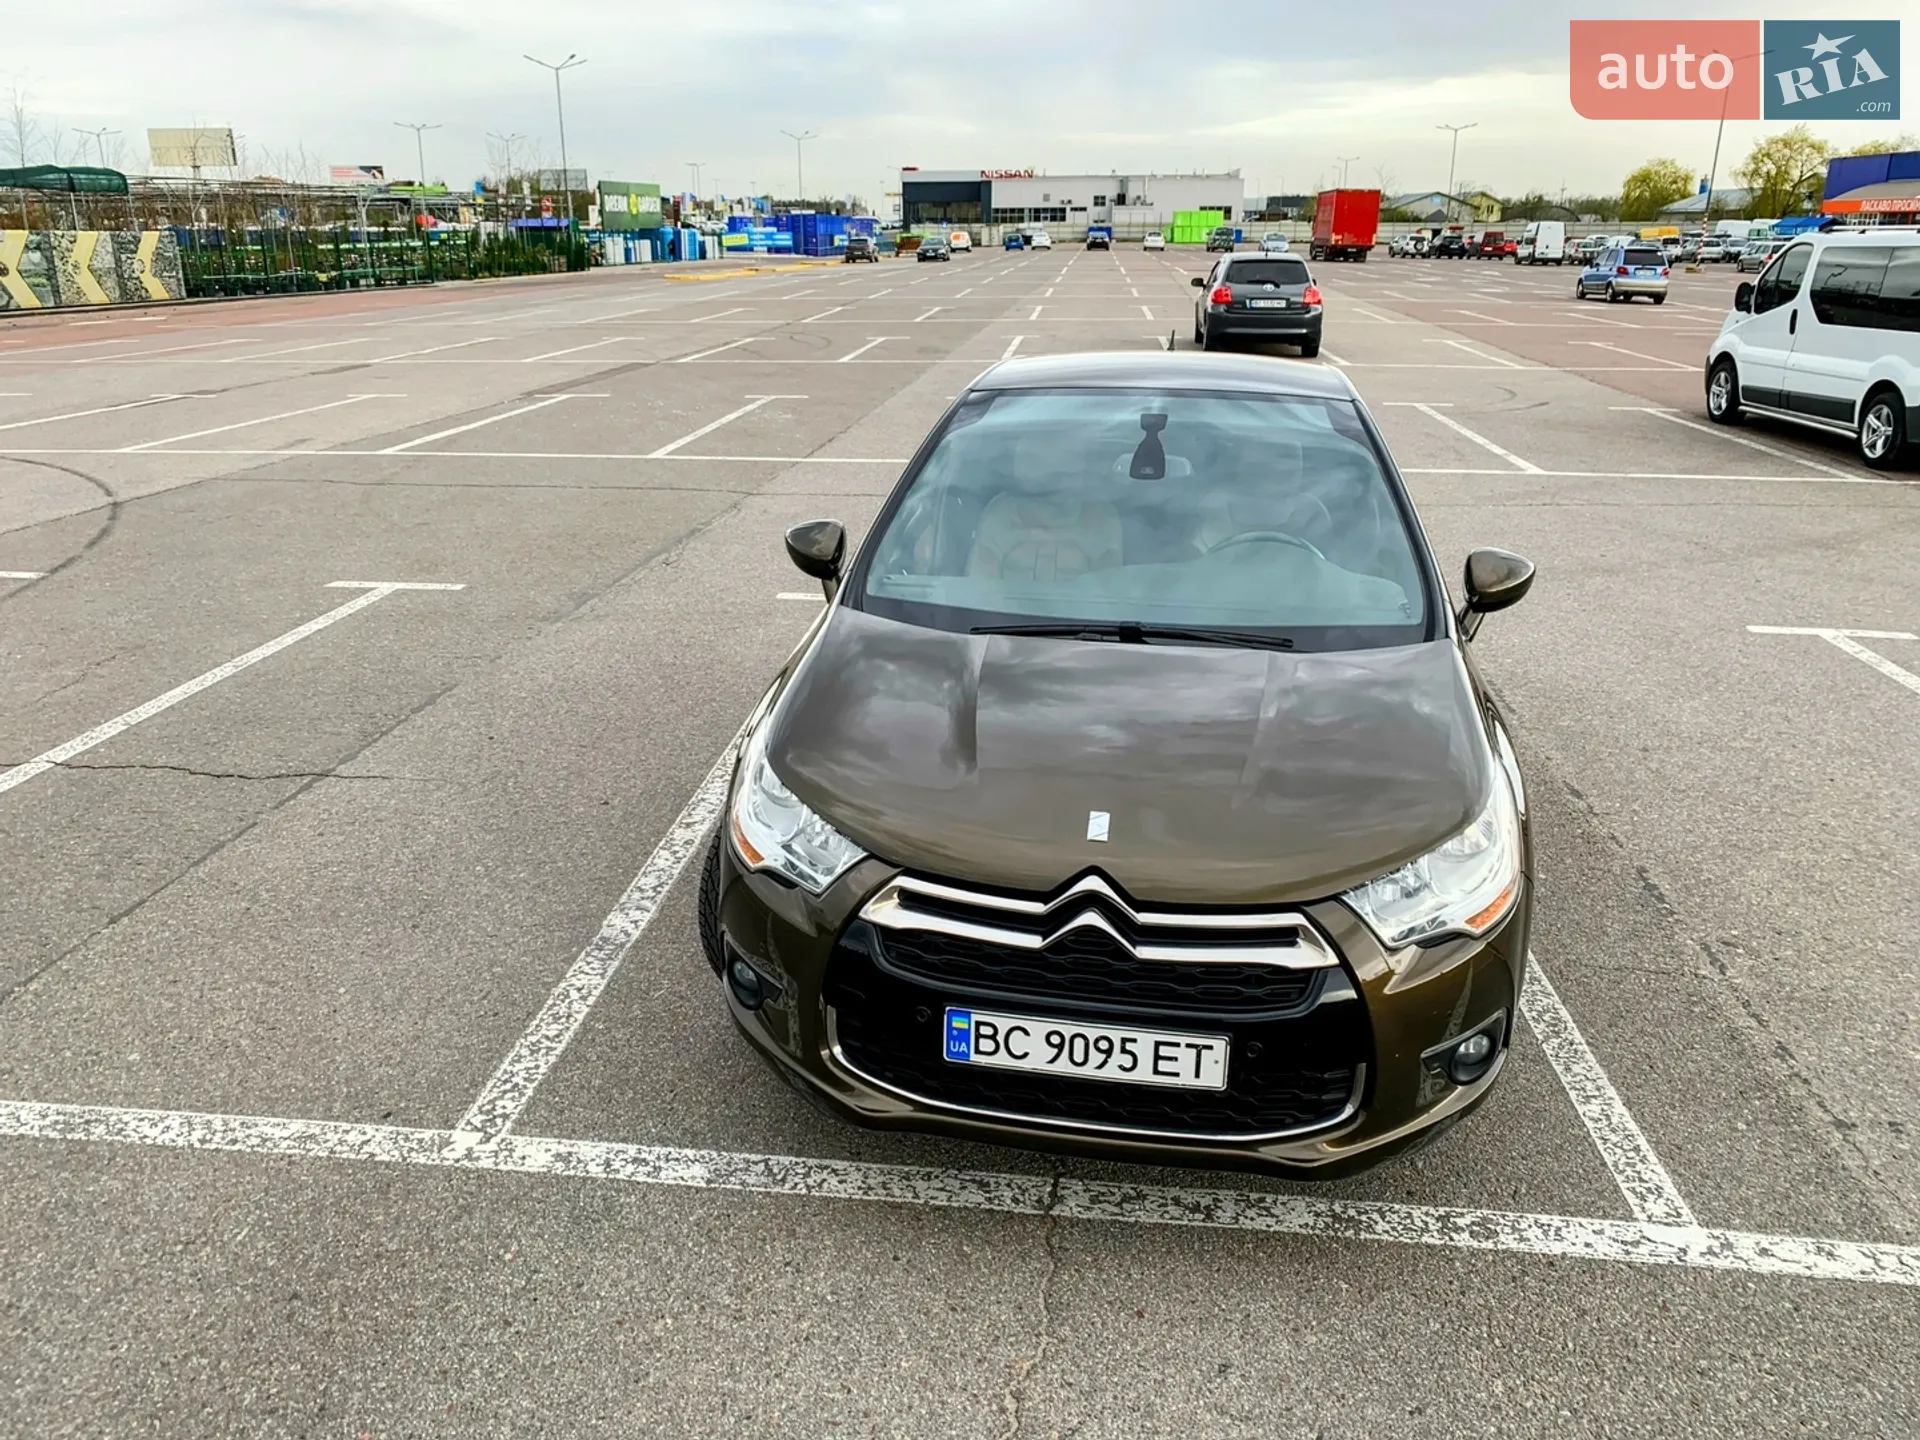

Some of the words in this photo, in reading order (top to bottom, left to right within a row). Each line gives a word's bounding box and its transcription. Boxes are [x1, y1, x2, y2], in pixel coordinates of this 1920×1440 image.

[980, 169, 1034, 179] NISSAN
[950, 1040, 968, 1054] UA
[974, 1020, 1031, 1060] BC
[1044, 1029, 1139, 1073] 9095
[1152, 1040, 1214, 1079] ET
